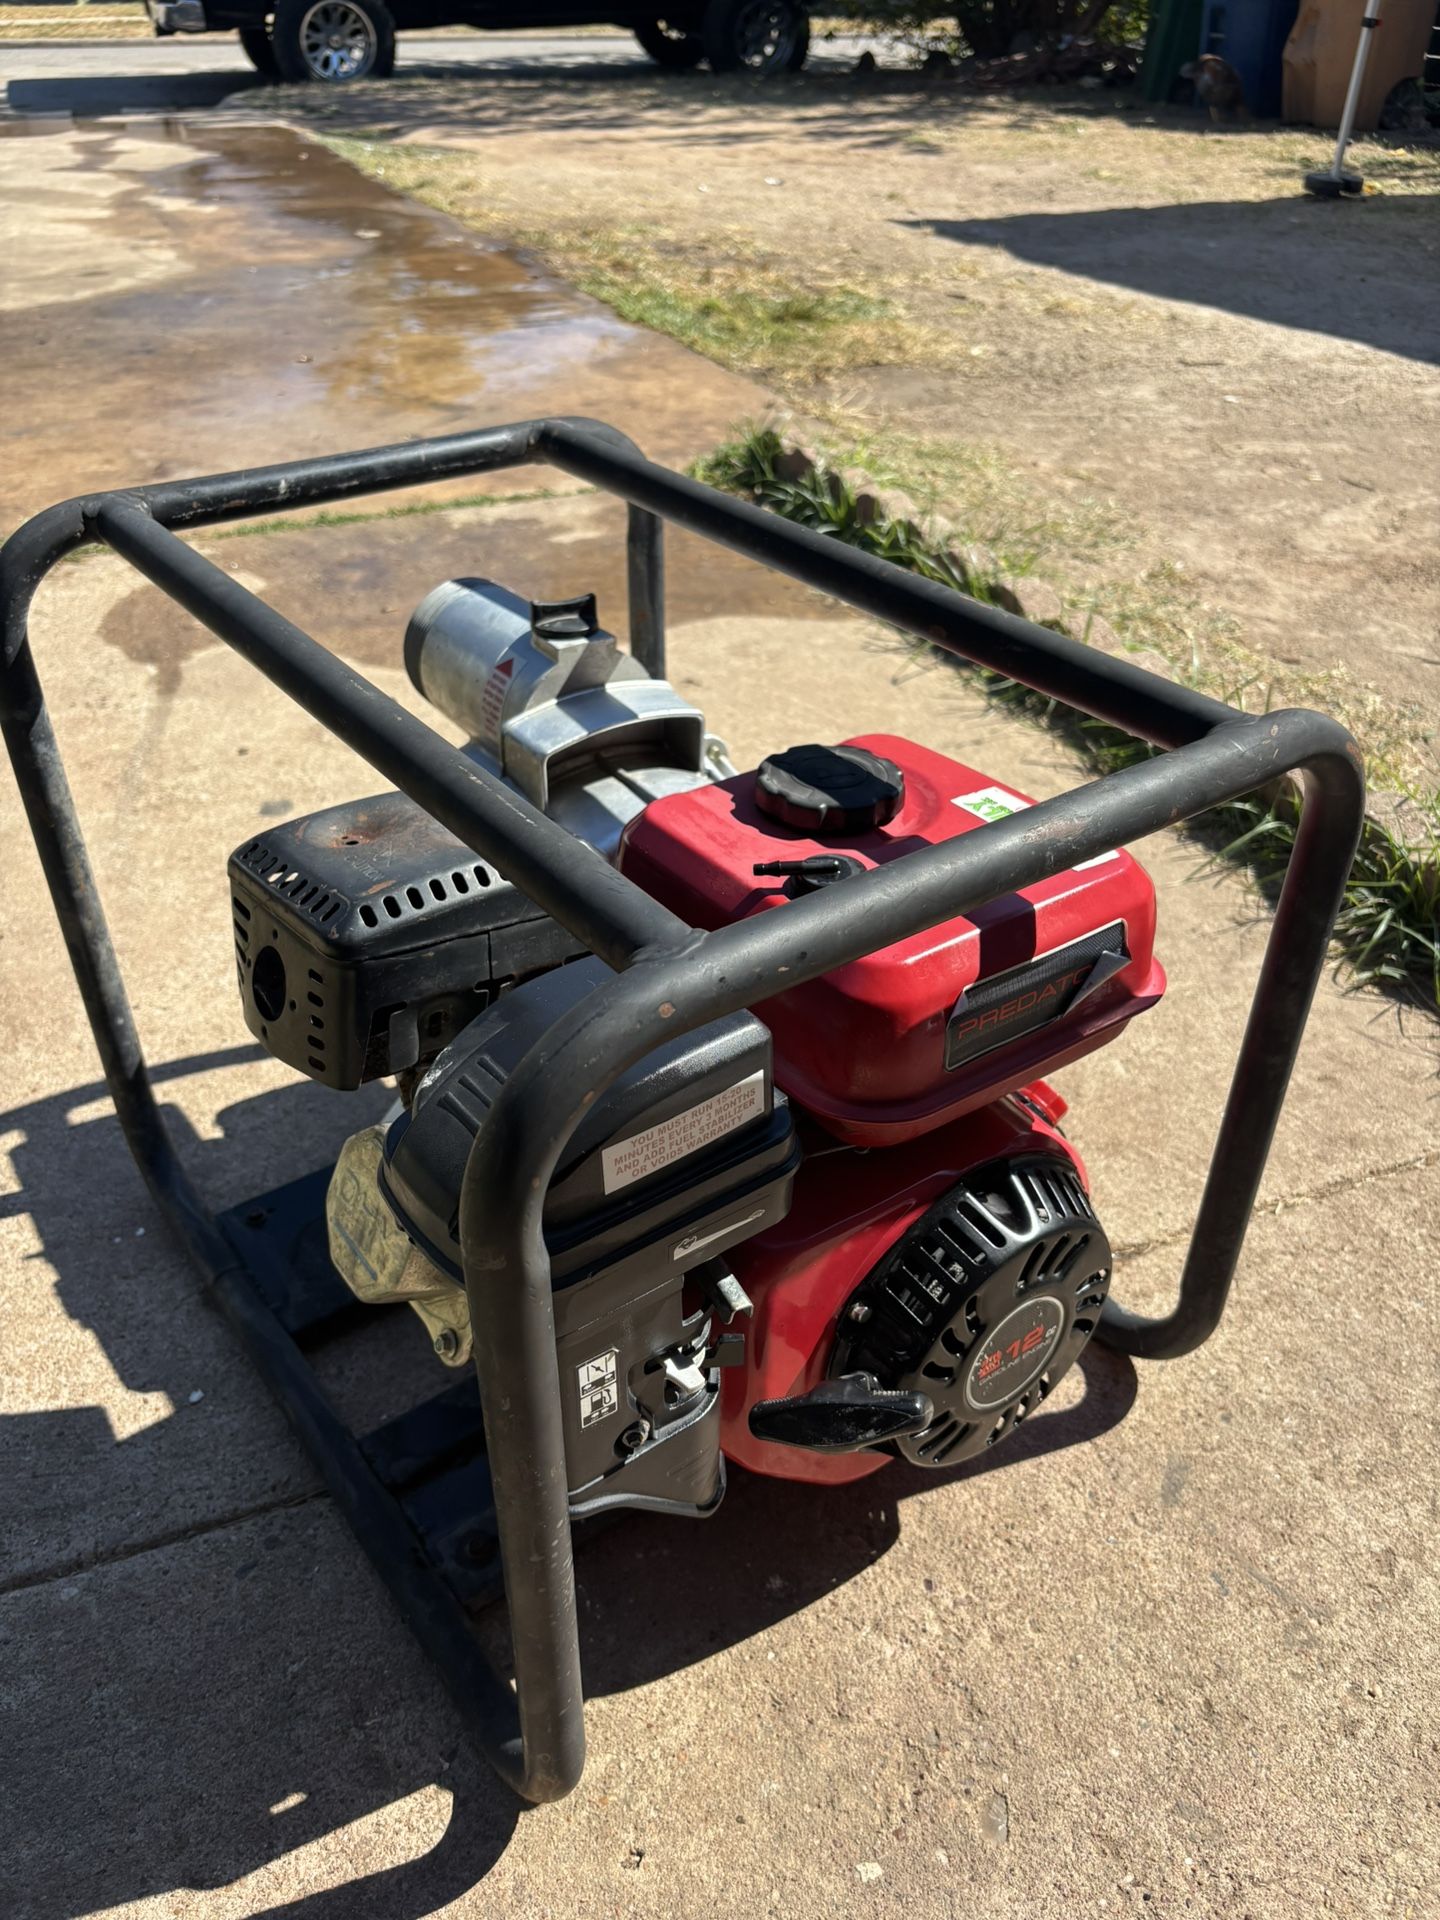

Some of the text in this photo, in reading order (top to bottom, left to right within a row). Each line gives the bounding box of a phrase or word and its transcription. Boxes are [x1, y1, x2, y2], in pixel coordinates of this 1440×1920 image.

[958, 965, 1093, 1040] PREDATO
[614, 1087, 756, 1167] MINUTES EVERY 3 MONTHS
[615, 1097, 755, 1177] AND ADD FUEL STABILIZER
[631, 1131, 654, 1148] YOU
[657, 1116, 688, 1135] MUST
[691, 1103, 713, 1119] RUN
[631, 1113, 743, 1178] OR VOIDS WARRANTY
